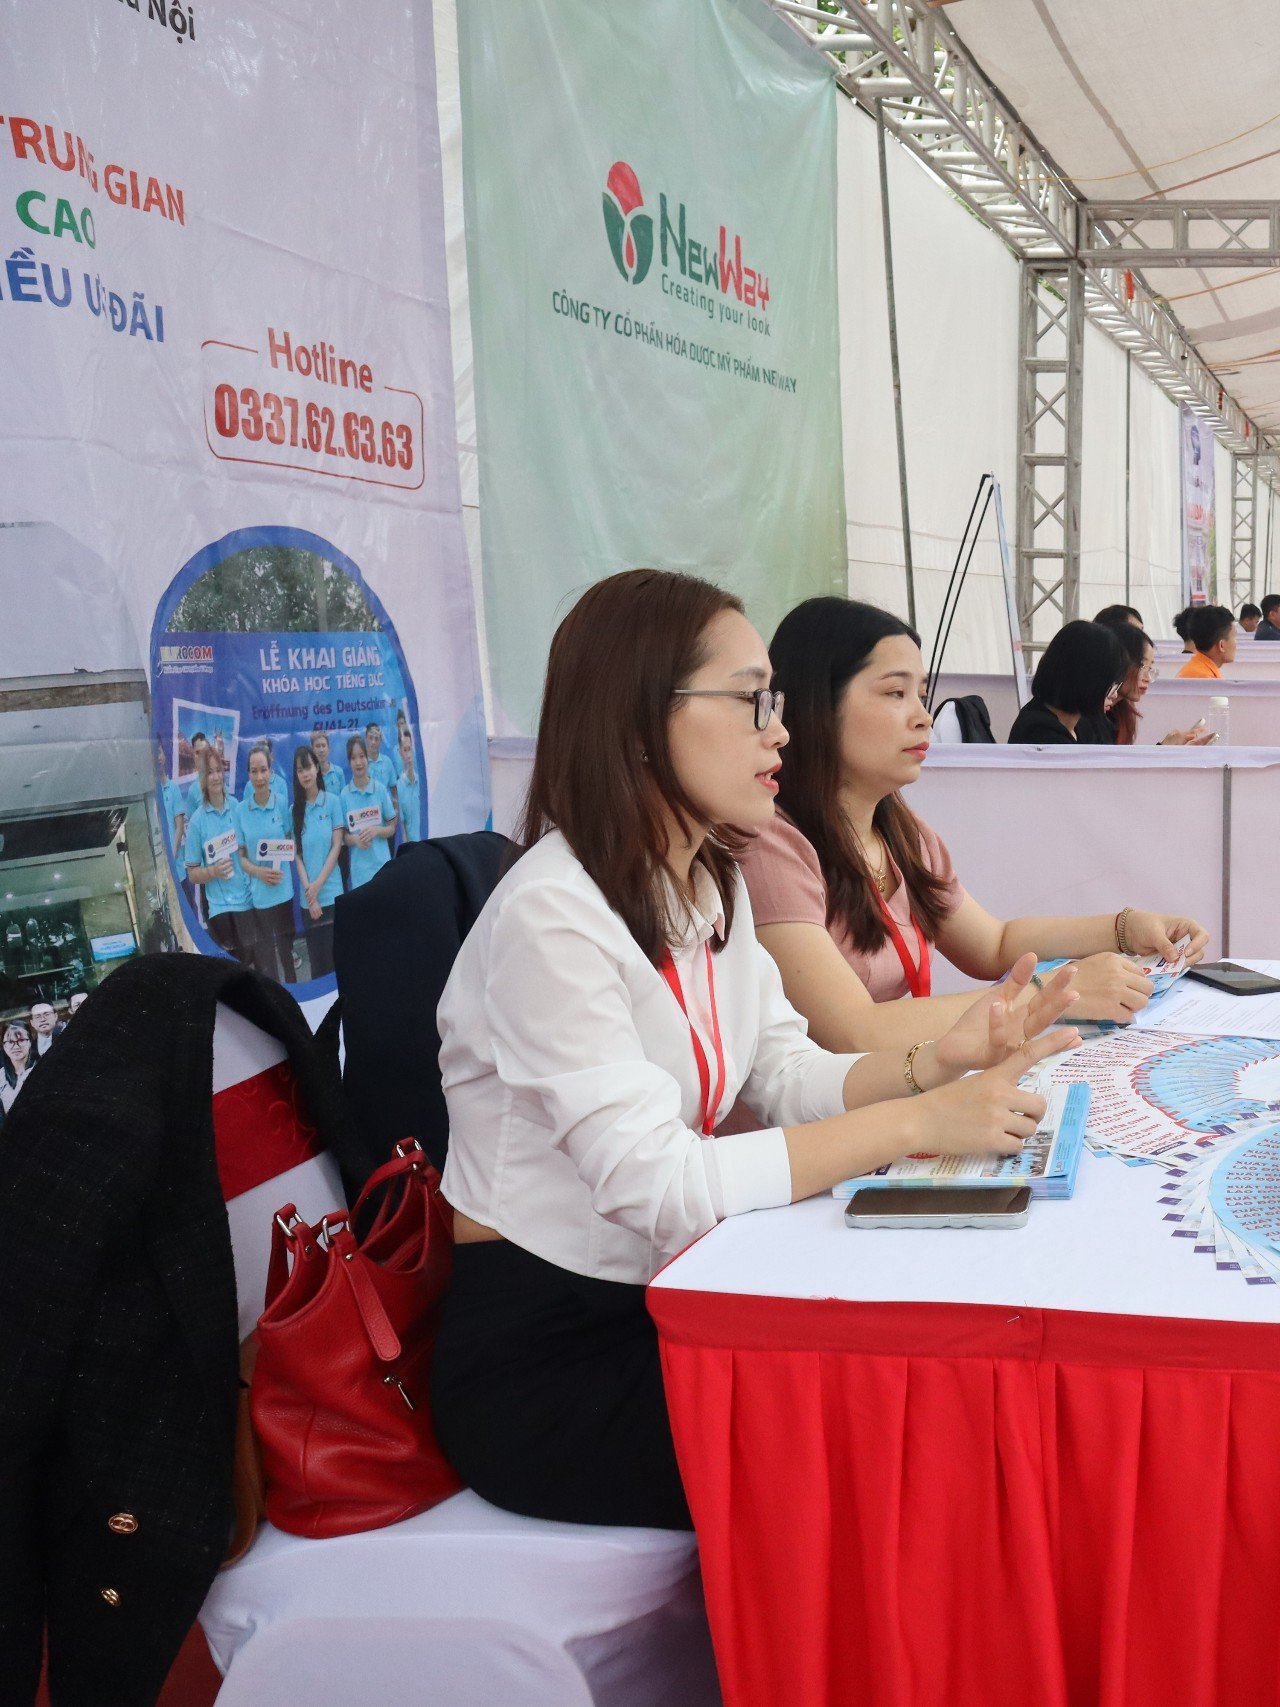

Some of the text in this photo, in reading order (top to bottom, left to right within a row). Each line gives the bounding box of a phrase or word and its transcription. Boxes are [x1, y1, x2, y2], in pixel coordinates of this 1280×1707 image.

[104, 164, 185, 226] GIAN
[109, 291, 164, 343] ĐÃI
[552, 289, 589, 324] CÔNG
[593, 306, 611, 330] TY
[662, 273, 771, 336] Creating your look
[268, 327, 373, 393] Hotline
[214, 383, 413, 470] 0337.62.63.63
[259, 640, 281, 671] LỄ
[288, 647, 336, 670] KHAI
[262, 674, 300, 693] KHÓA
[304, 675, 331, 693] HỌC
